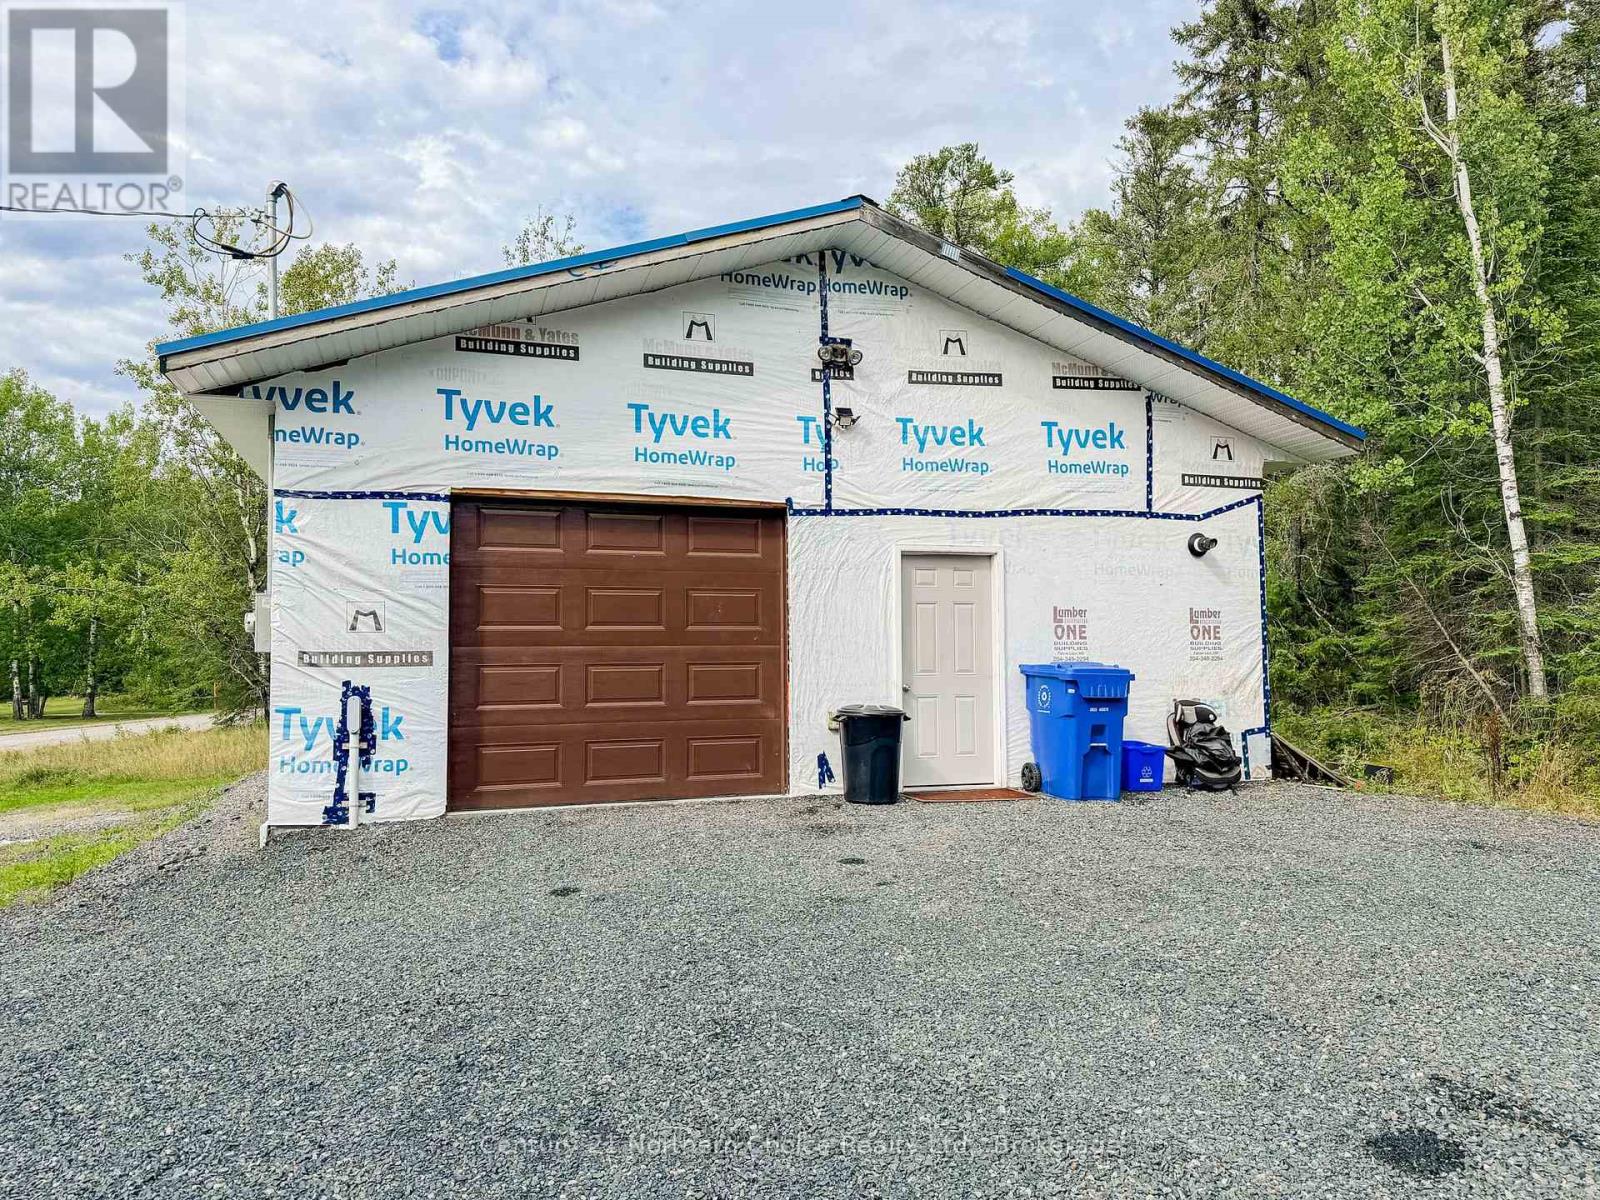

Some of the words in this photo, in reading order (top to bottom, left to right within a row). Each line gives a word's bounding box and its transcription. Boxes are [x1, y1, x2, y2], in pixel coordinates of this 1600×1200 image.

[539, 328, 579, 345] Yates
[460, 339, 515, 353] Building
[520, 344, 575, 357] Supplies
[648, 356, 696, 369] Building
[701, 360, 750, 373] Supplies
[912, 373, 953, 383] Building
[957, 374, 1000, 384] Supplies
[1055, 378, 1095, 388] Building
[1098, 379, 1139, 389] Supplies
[437, 388, 555, 431] Tyvek
[627, 403, 732, 443] Tyvek
[895, 417, 985, 453] Tyvek
[1041, 421, 1125, 456] Tyvek
[445, 434, 559, 460] HomeWrap
[634, 447, 736, 469] HomeWrap
[902, 457, 990, 476] HomeWrap
[1048, 460, 1129, 478] HomeWrap
[1184, 475, 1221, 486] Building
[1223, 477, 1261, 488] Supplies
[1053, 606, 1088, 624] Lumber
[1189, 607, 1221, 624] Lumber
[1054, 624, 1088, 640] ONE
[1190, 625, 1221, 640] ONE
[303, 653, 361, 666] Building
[367, 653, 429, 665] Supplies
